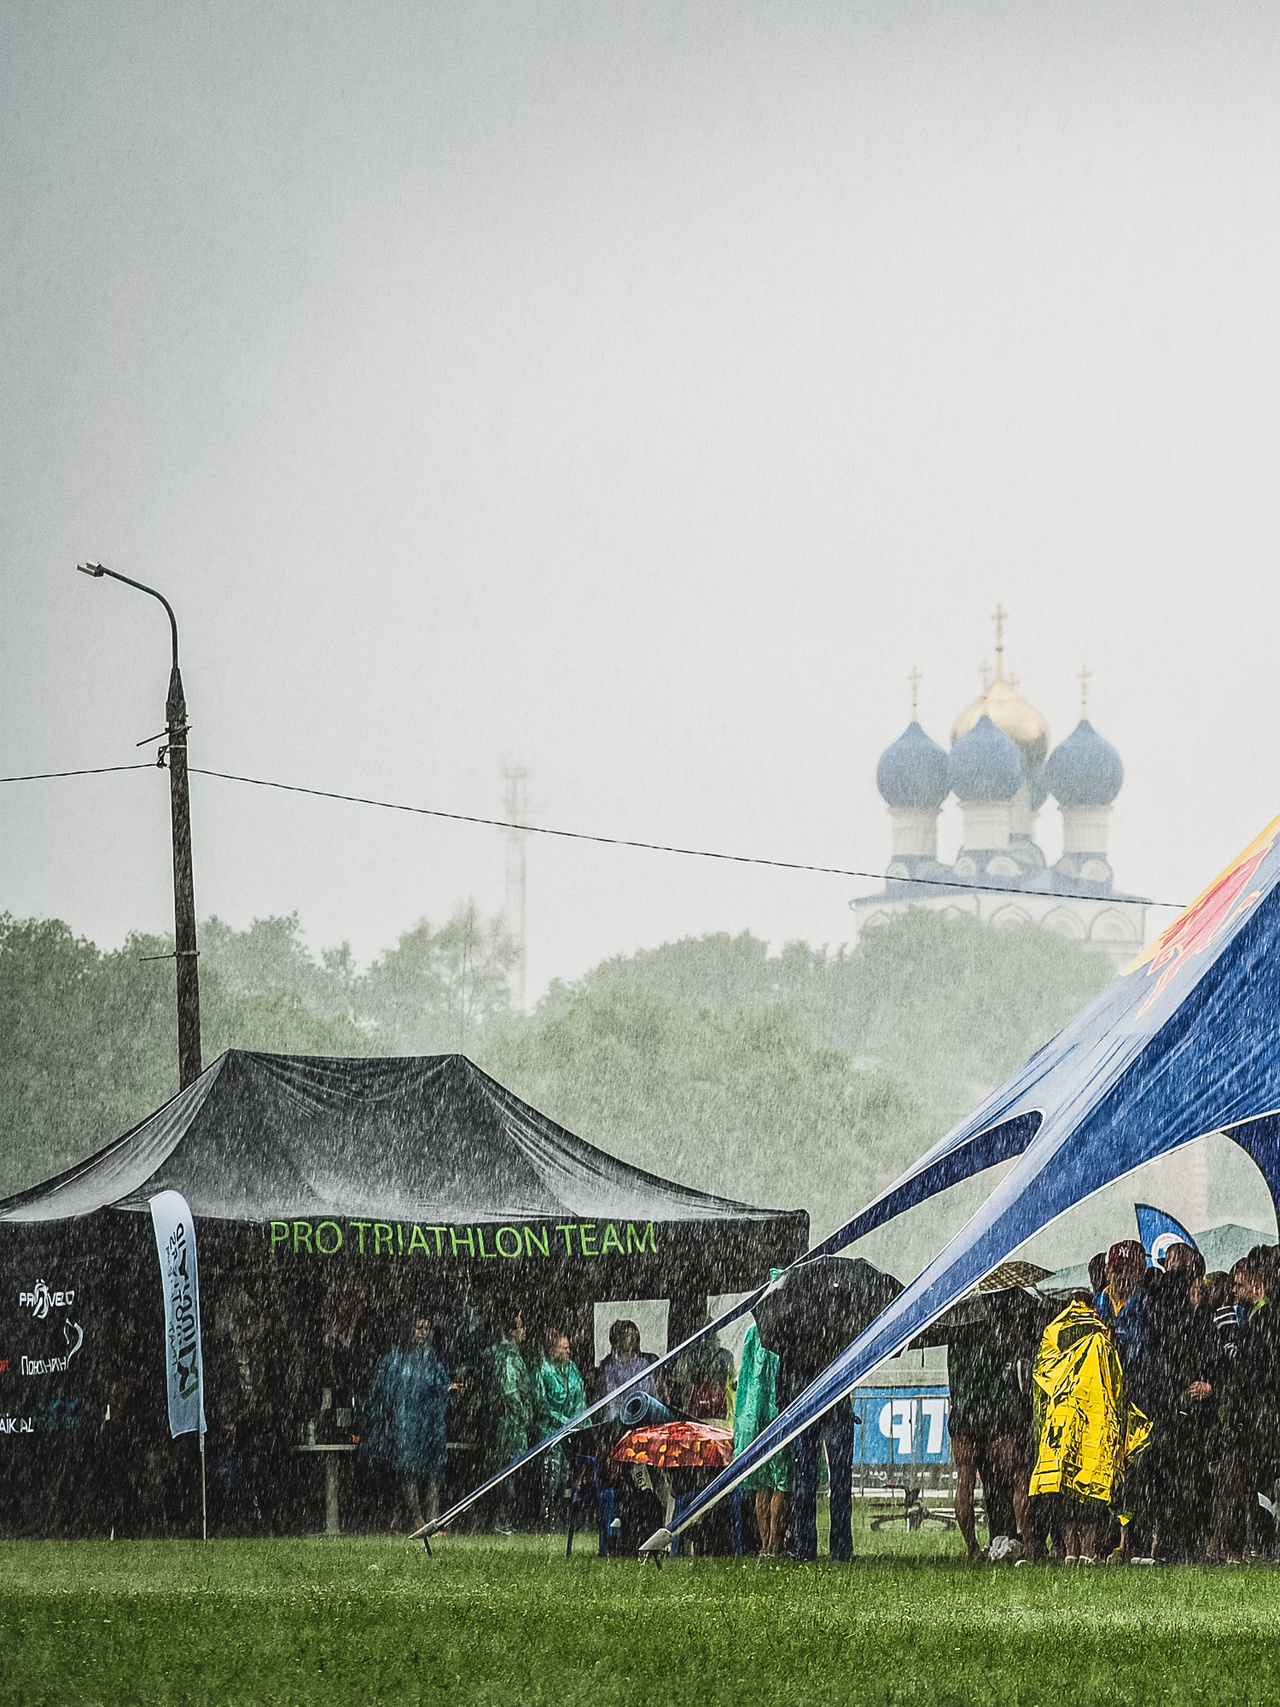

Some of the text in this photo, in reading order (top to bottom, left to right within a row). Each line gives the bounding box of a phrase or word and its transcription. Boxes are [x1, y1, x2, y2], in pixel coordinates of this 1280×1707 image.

[270, 1221, 659, 1258] PRO TRIATHLON TEAM
